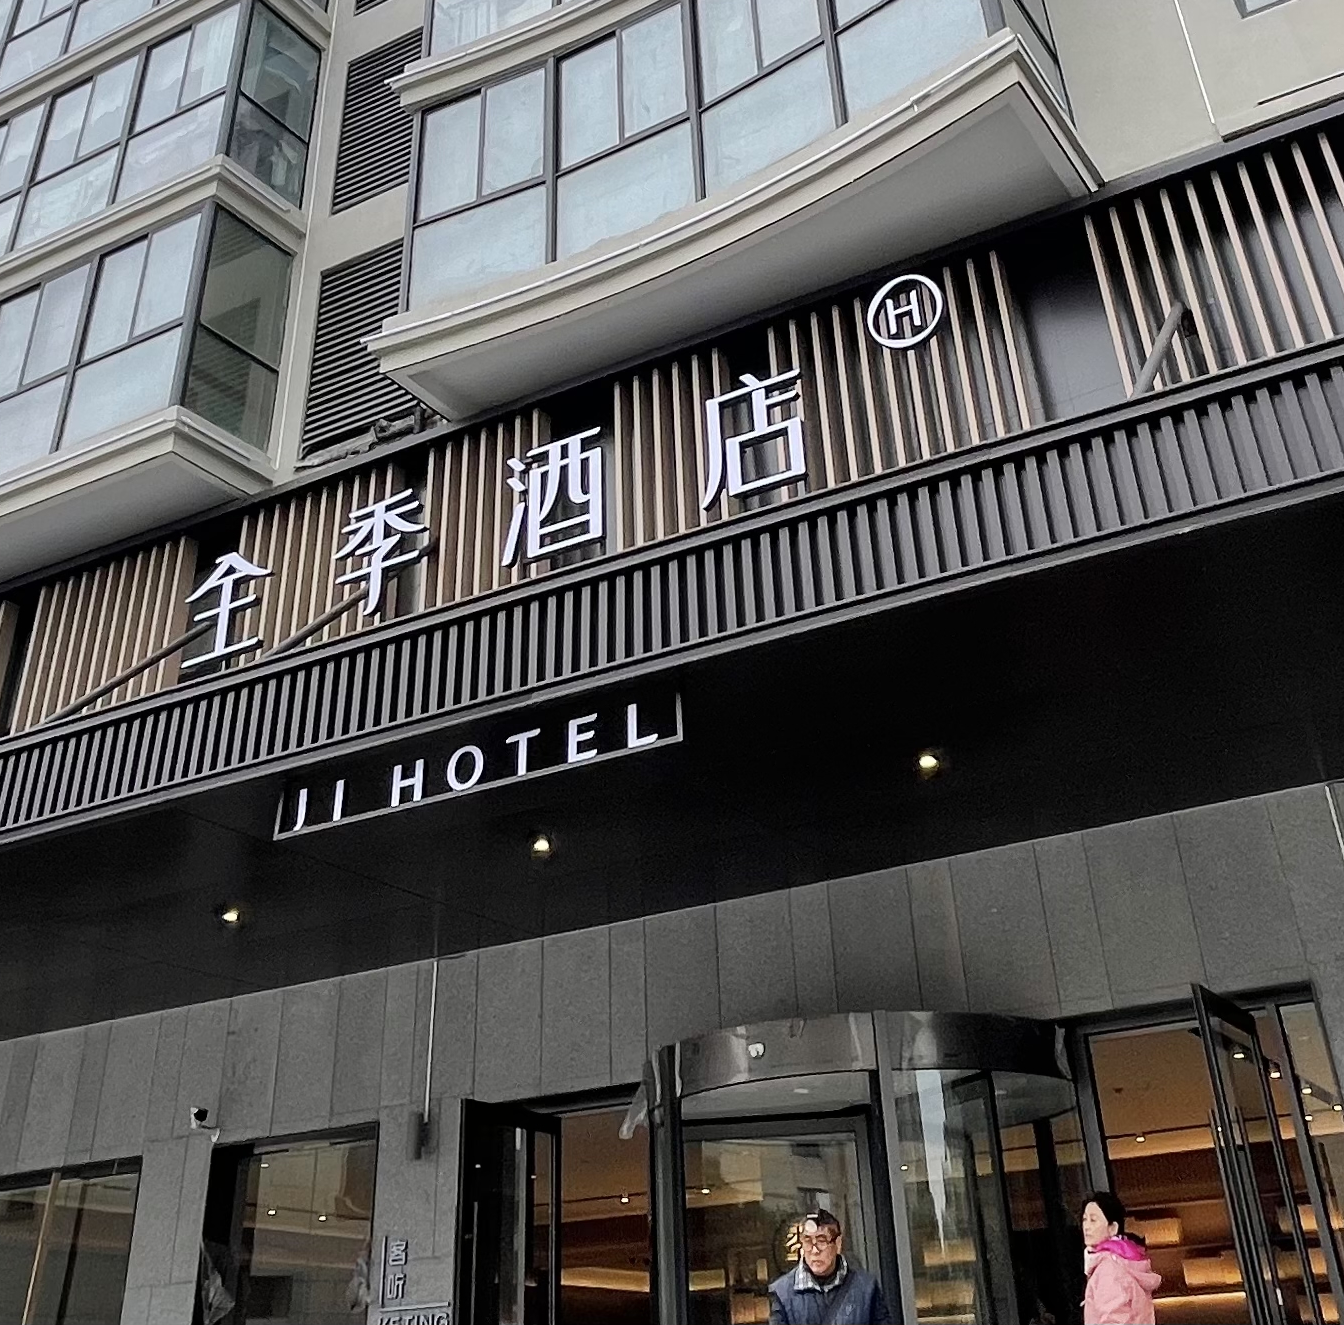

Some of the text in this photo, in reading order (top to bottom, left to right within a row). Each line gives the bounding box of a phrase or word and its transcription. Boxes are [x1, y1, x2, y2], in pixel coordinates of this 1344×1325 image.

[180, 367, 808, 670] 全季酒店
[293, 703, 659, 831] JI HOTEL
